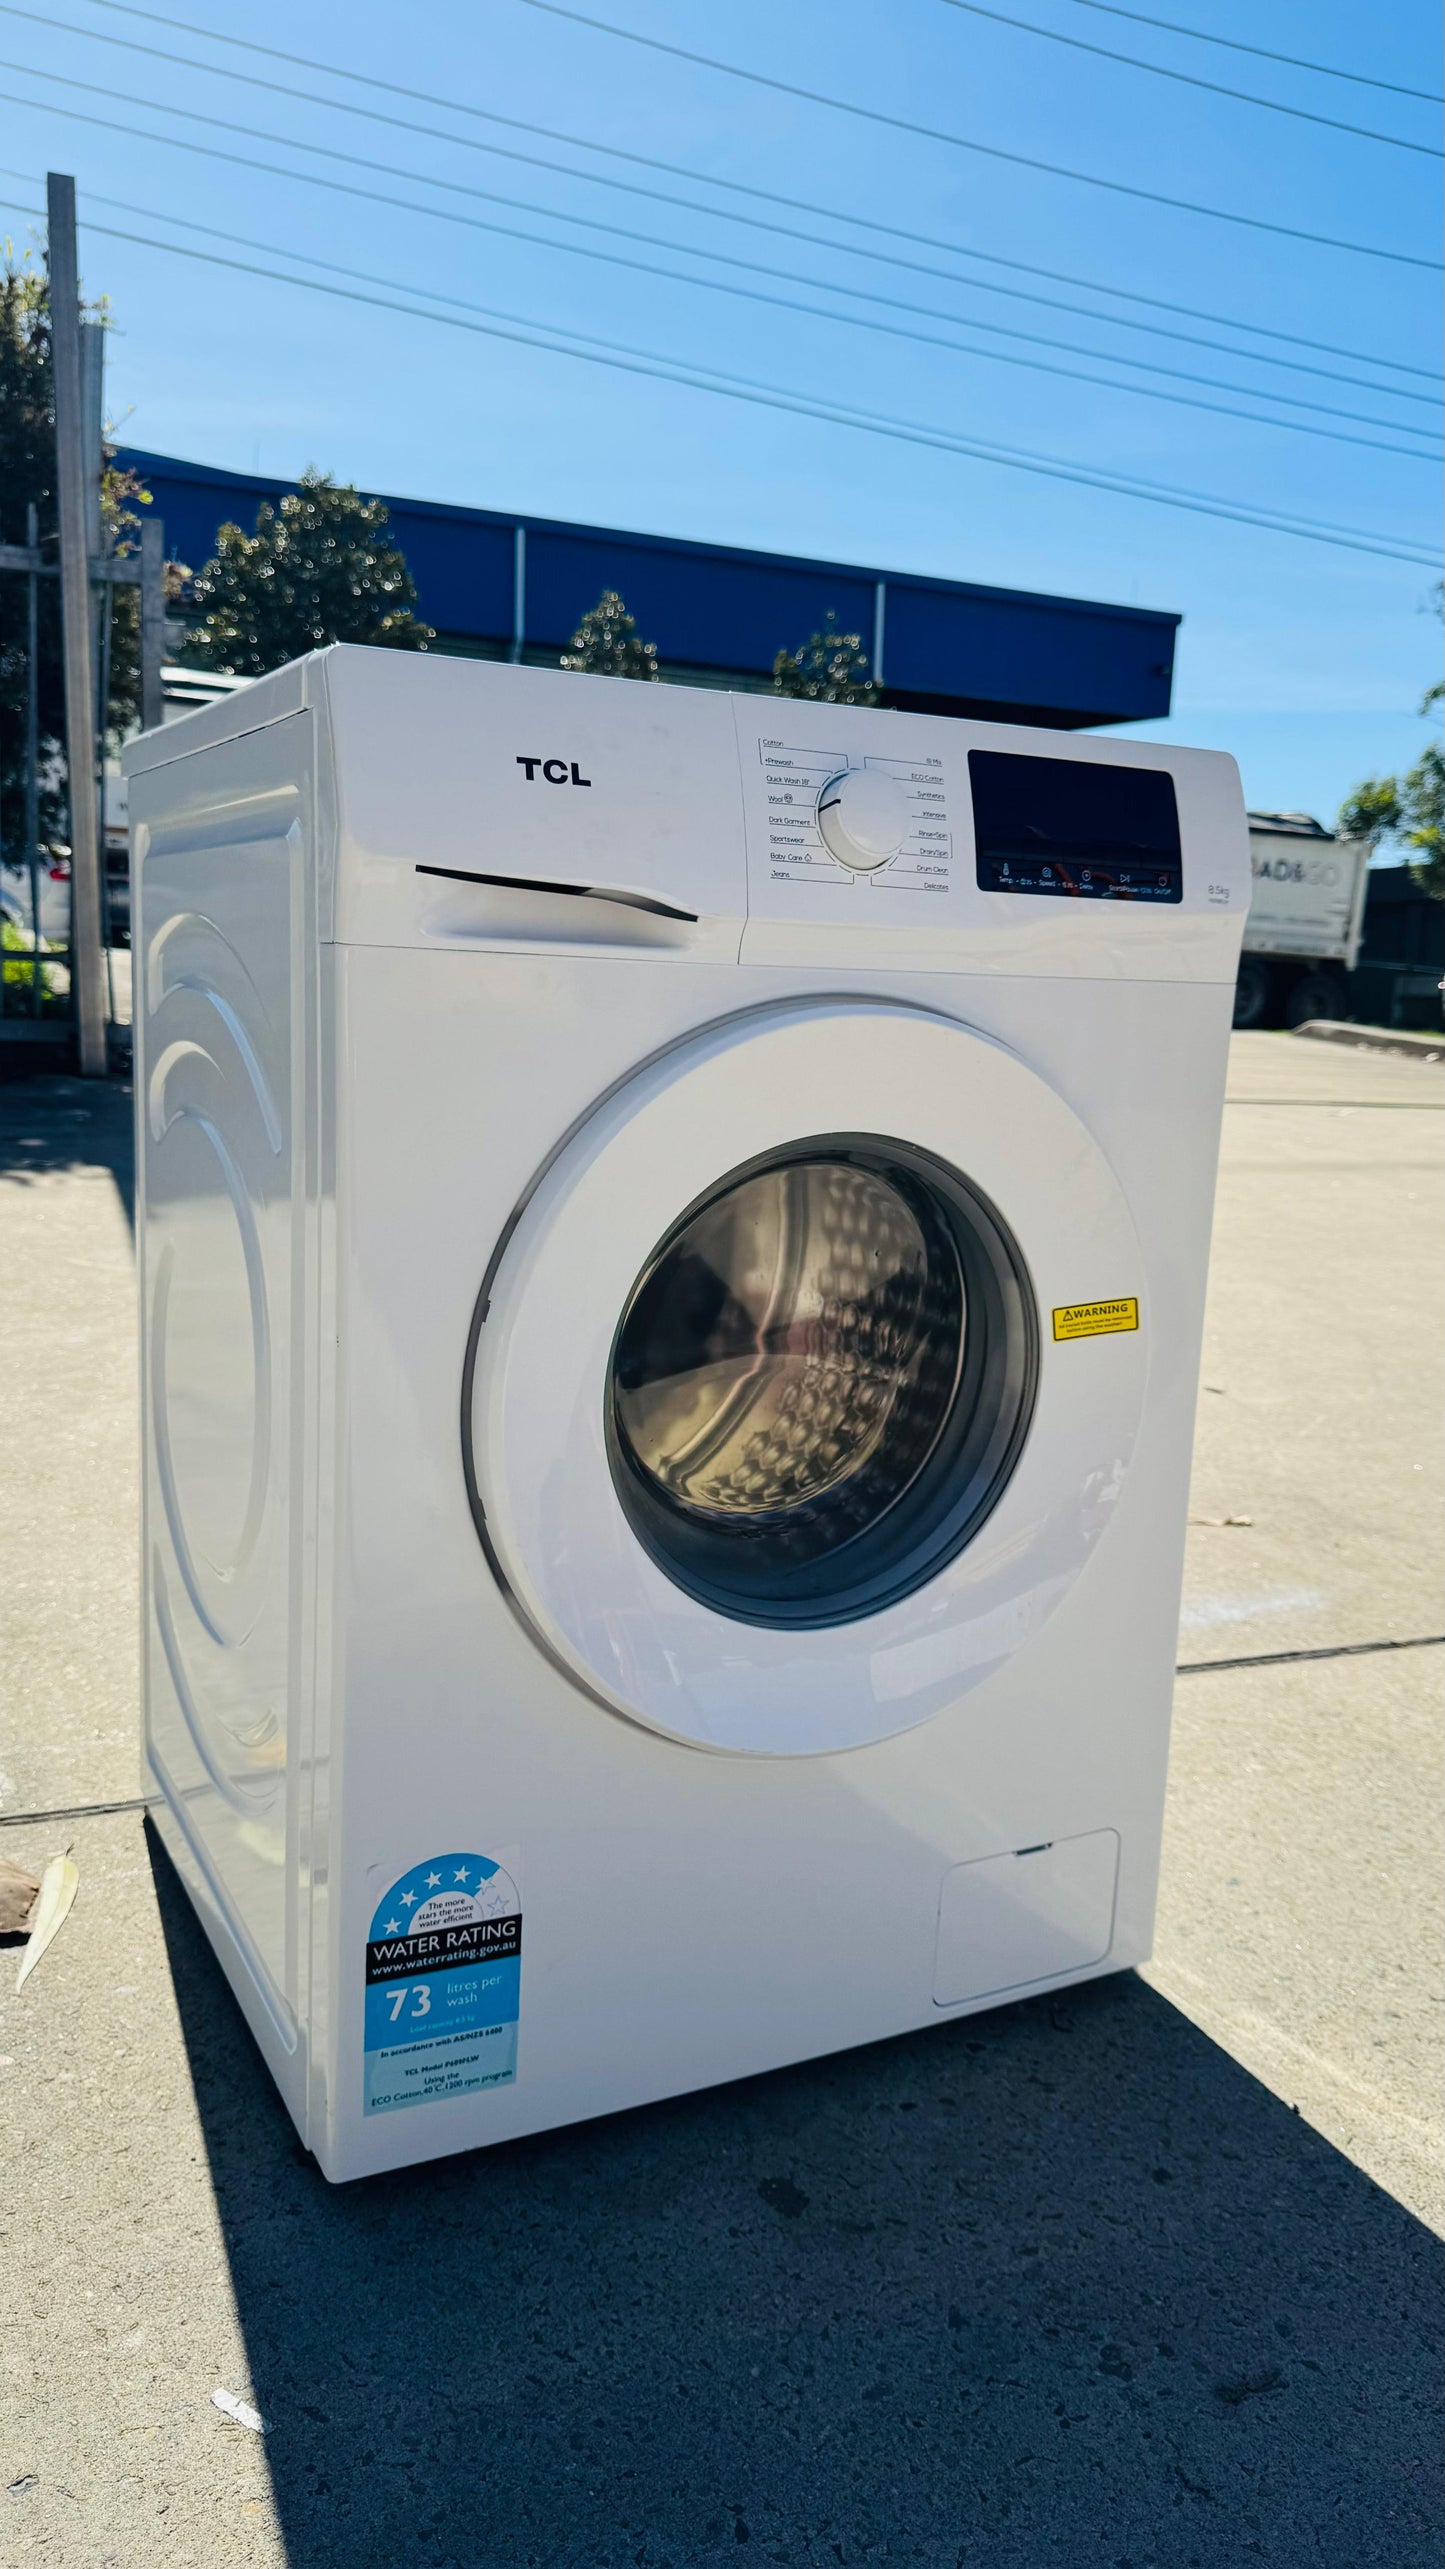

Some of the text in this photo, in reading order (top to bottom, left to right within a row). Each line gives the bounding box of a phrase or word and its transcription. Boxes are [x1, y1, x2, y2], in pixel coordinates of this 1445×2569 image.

[763, 739, 784, 747] Cotton
[765, 758, 794, 766] +Prewash
[516, 756, 592, 787] TCL
[911, 773, 924, 781] ECO
[766, 775, 782, 783] Quick
[784, 777, 800, 785] Wash
[768, 795, 783, 803] Wool
[917, 791, 945, 800] Synthetics
[769, 816, 810, 826] Dark Garment
[769, 835, 805, 844] Sportswear
[770, 852, 803, 862] Baby Care
[771, 870, 790, 878] Jeans
[916, 865, 949, 874] Drum Clean
[924, 882, 949, 890] Delicates
[1073, 1303, 1128, 1319] WARNING
[428, 1898, 466, 1911] The more
[418, 1904, 474, 1921] stars the more
[419, 1912, 473, 1929] water efficient
[373, 1920, 517, 1961] WATER RATING
[371, 1941, 517, 1976] www.waterrating.gov.au
[447, 1974, 502, 1995] litres per
[386, 1984, 432, 2022] 73
[447, 1992, 478, 2007] wash
[380, 2051, 389, 2059] In
[391, 2041, 434, 2057] accordance
[435, 2037, 452, 2047] with
[404, 2066, 419, 2077] TCL
[421, 2062, 444, 2073] Model
[424, 2071, 460, 2085] Using the
[371, 2095, 392, 2107] ECO
[464, 2076, 481, 2088] rpm
[481, 2069, 513, 2084] program
